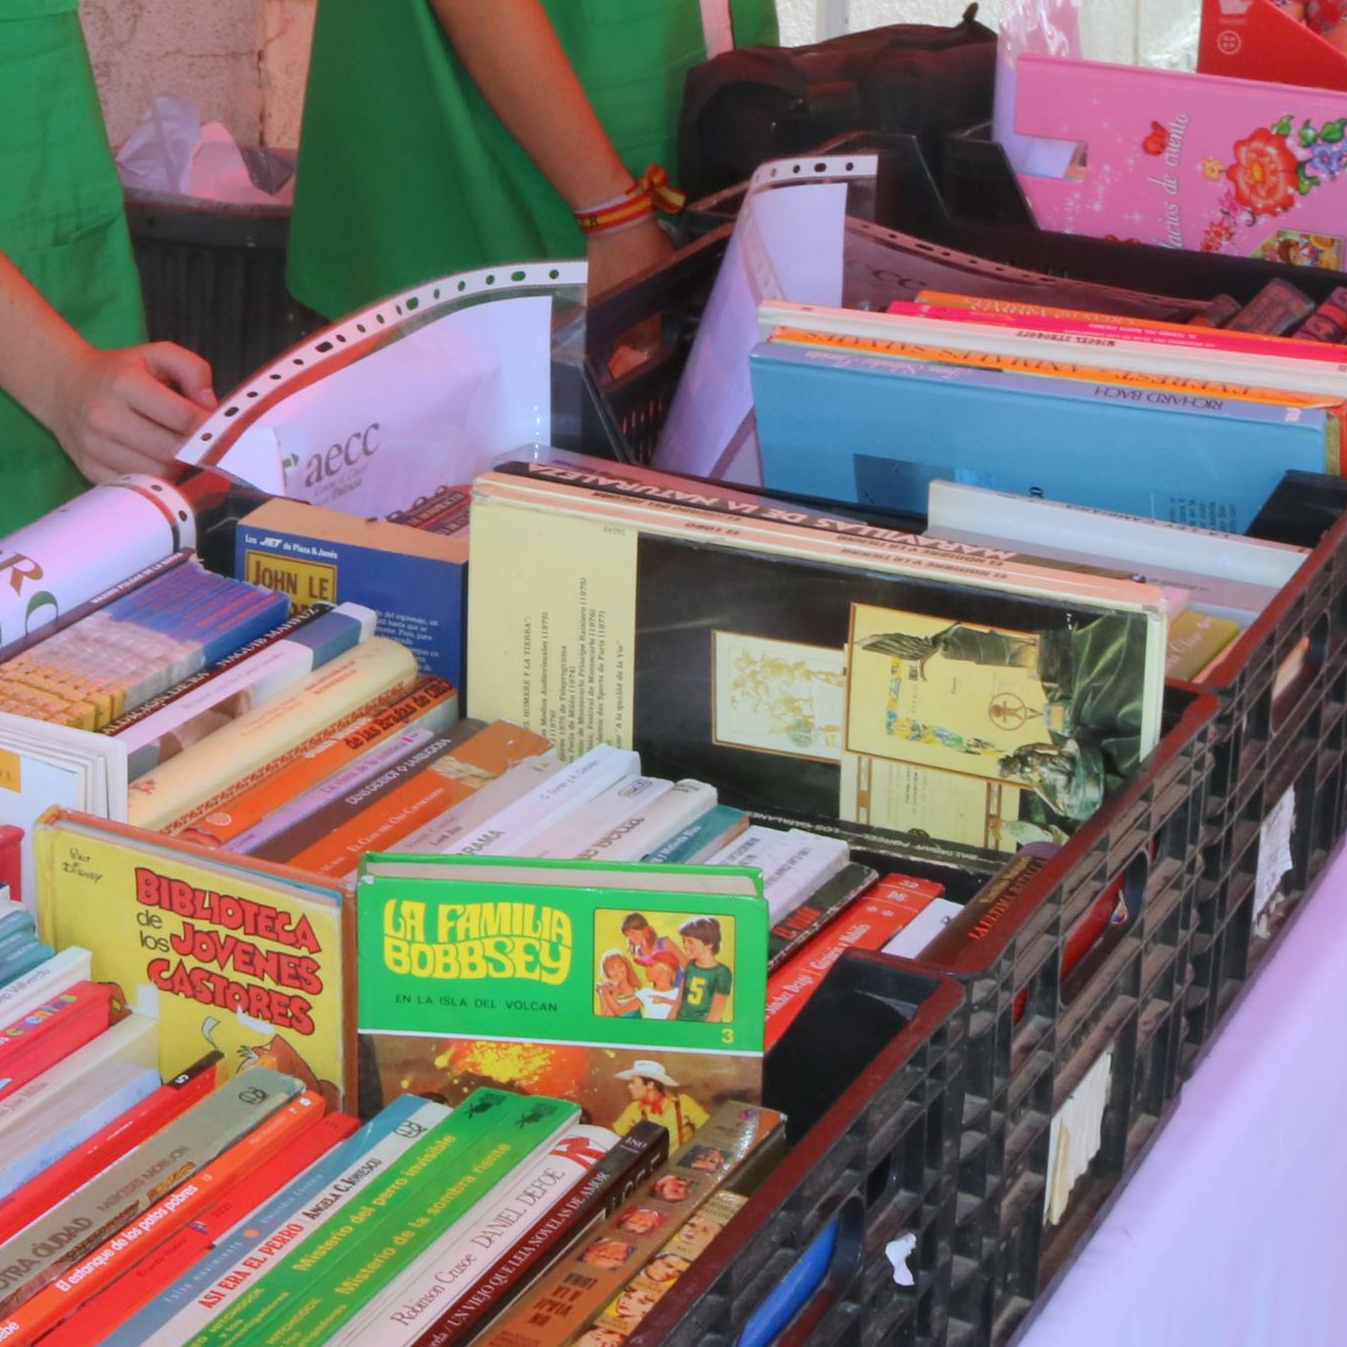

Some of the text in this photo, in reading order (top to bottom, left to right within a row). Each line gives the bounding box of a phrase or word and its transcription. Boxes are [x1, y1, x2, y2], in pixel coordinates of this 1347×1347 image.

[1093, 385, 1224, 411] RICHARD BACH
[305, 423, 380, 487] aecc
[527, 463, 1015, 561] MARAVILLAS DE LA NATURALEZA
[253, 560, 330, 599] JOHN LE
[134, 867, 323, 954] BIBLIOTECA
[136, 909, 163, 930] de
[383, 898, 572, 949] LA FAMILIA
[139, 921, 324, 996] los JOVENES
[383, 935, 572, 985] BOBBSEY
[4, 988, 77, 1041] cuentos
[146, 958, 316, 1036] CASTORES
[396, 994, 557, 1012] EN LA ISLA DEL VOLCAN
[687, 976, 707, 1006] 5
[721, 1028, 734, 1044] 3
[293, 1129, 457, 1276] Misterio del perro invisible
[334, 1138, 511, 1300] Misterio de la sombra riente
[32, 1210, 94, 1262] CIUDAD
[54, 1275, 72, 1294] El
[65, 1244, 115, 1287] estanque
[108, 1232, 129, 1253] de
[123, 1221, 144, 1243] los
[137, 1204, 170, 1235] patos
[163, 1181, 201, 1214] pobres
[197, 1284, 226, 1313] ASI
[219, 1263, 251, 1293] ERA
[245, 1248, 269, 1271] EL
[261, 1217, 305, 1258] PERRO
[302, 1186, 342, 1223] ANGELA
[391, 1161, 565, 1330] Robinson Crusoe DANIEL DEFOE
[445, 1168, 612, 1330] UN VIEJO QUE LEIA NOVELAS DE AMOR
